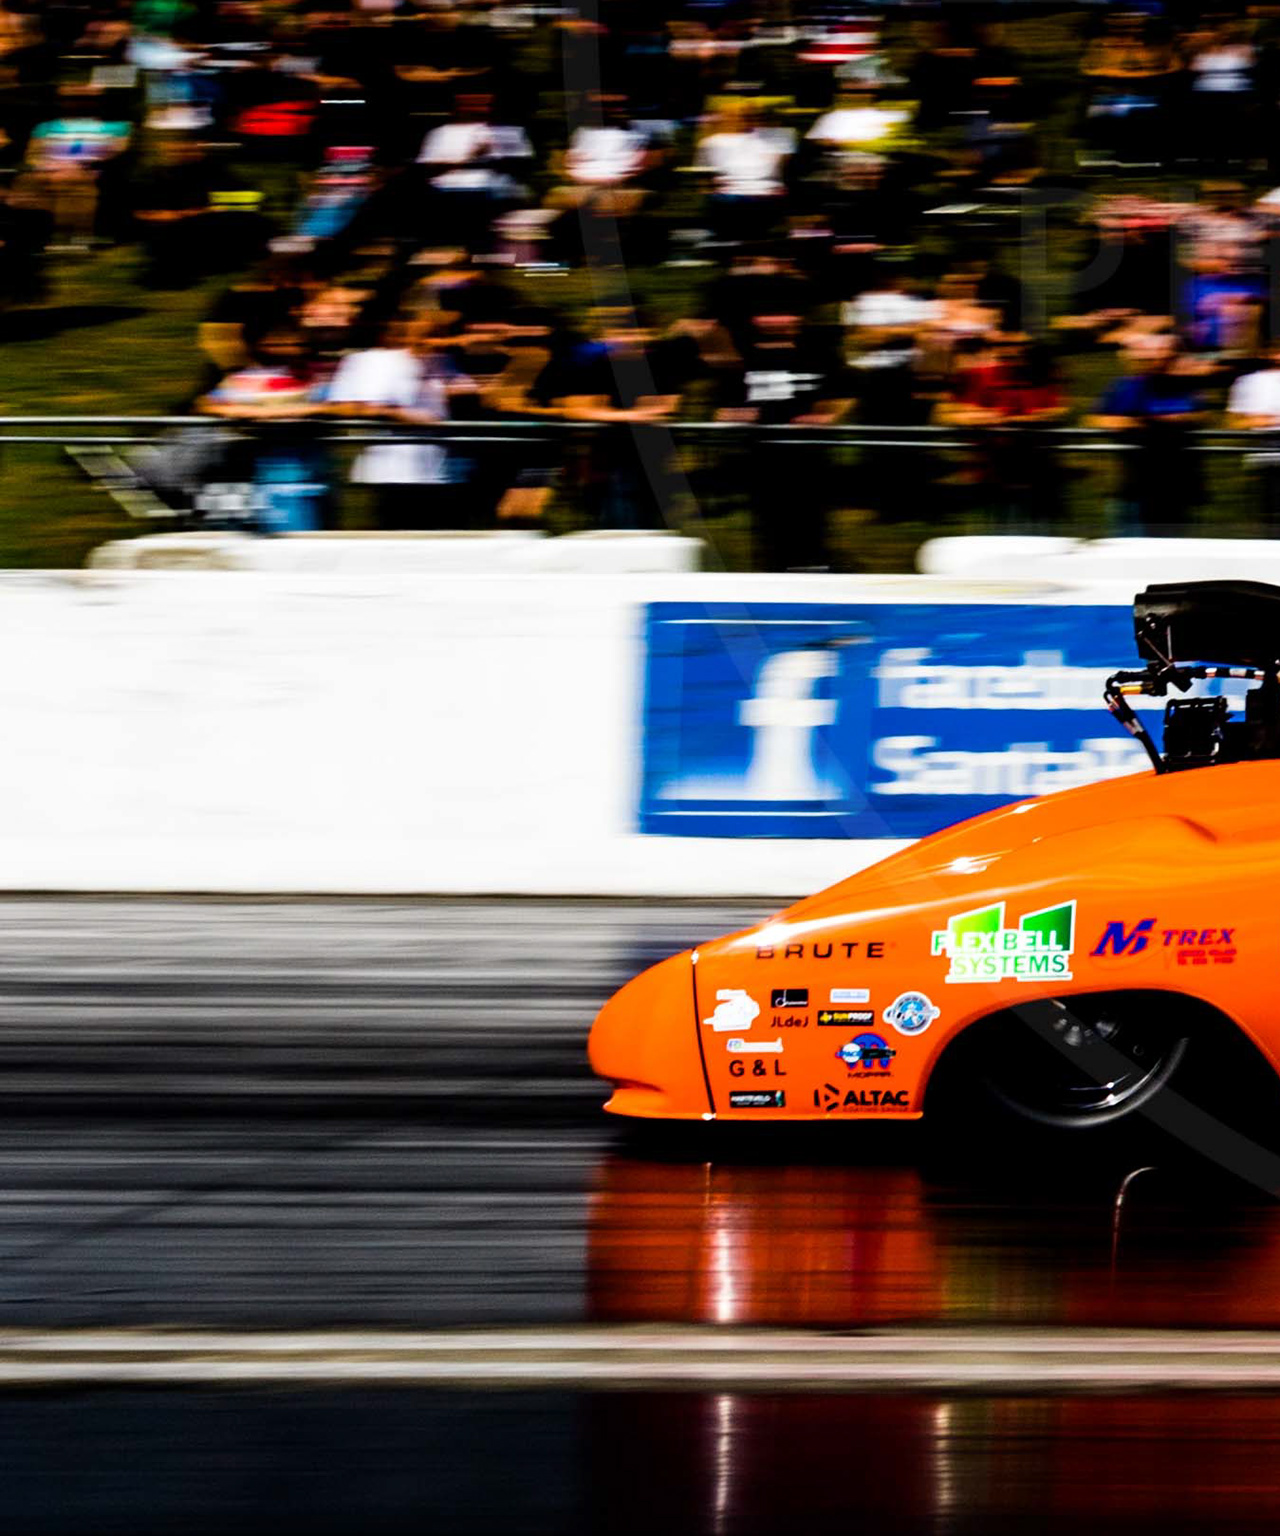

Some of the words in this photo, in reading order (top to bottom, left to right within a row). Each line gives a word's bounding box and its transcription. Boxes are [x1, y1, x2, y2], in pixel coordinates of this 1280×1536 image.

[1161, 928, 1236, 947] TREX
[756, 941, 885, 960] BRUTE
[953, 954, 1066, 975] SYSTEMS
[728, 1059, 745, 1078] G
[752, 1059, 767, 1077] &
[774, 1058, 787, 1076] L
[842, 1090, 910, 1107] ALTAC
